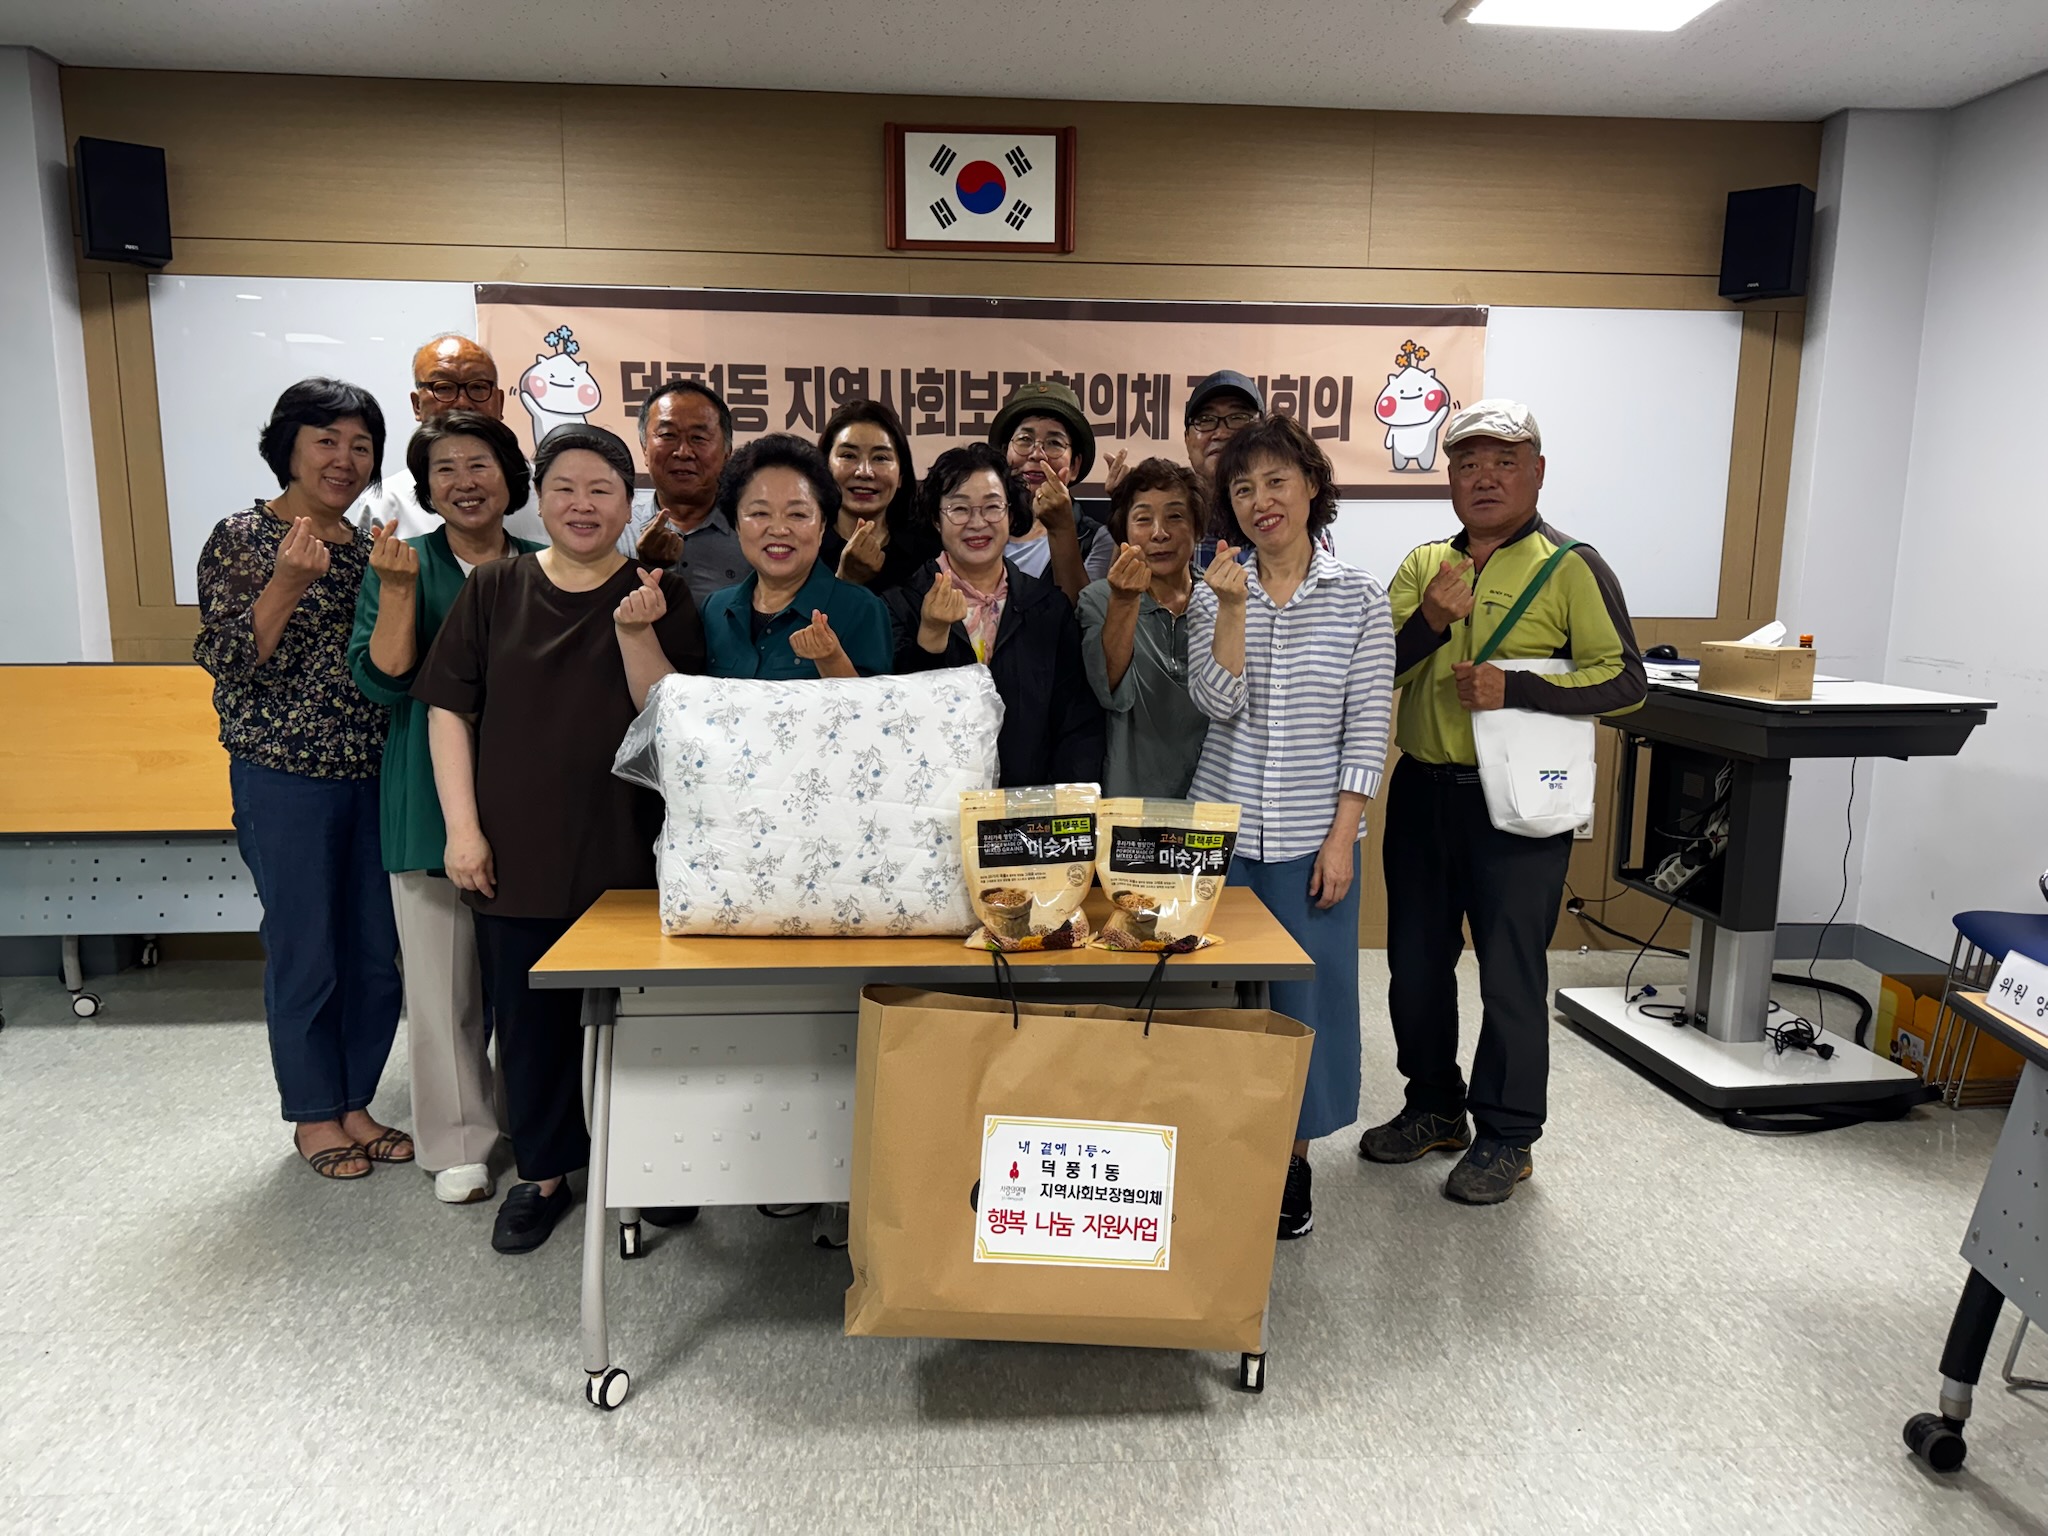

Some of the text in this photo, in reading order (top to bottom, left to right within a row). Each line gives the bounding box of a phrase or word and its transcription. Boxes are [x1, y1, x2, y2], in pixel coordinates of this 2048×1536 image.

[1028, 835, 1094, 858] 미숫가루
[1159, 847, 1224, 870] 미숫가루
[1999, 977, 2028, 1005] 위원
[1018, 1141, 1031, 1155] 내
[1040, 1142, 1067, 1156] 곁에
[1040, 1183, 1162, 1206] 지역사회보장협의체
[987, 1208, 1158, 1242] 행복 나눔 지원사업
